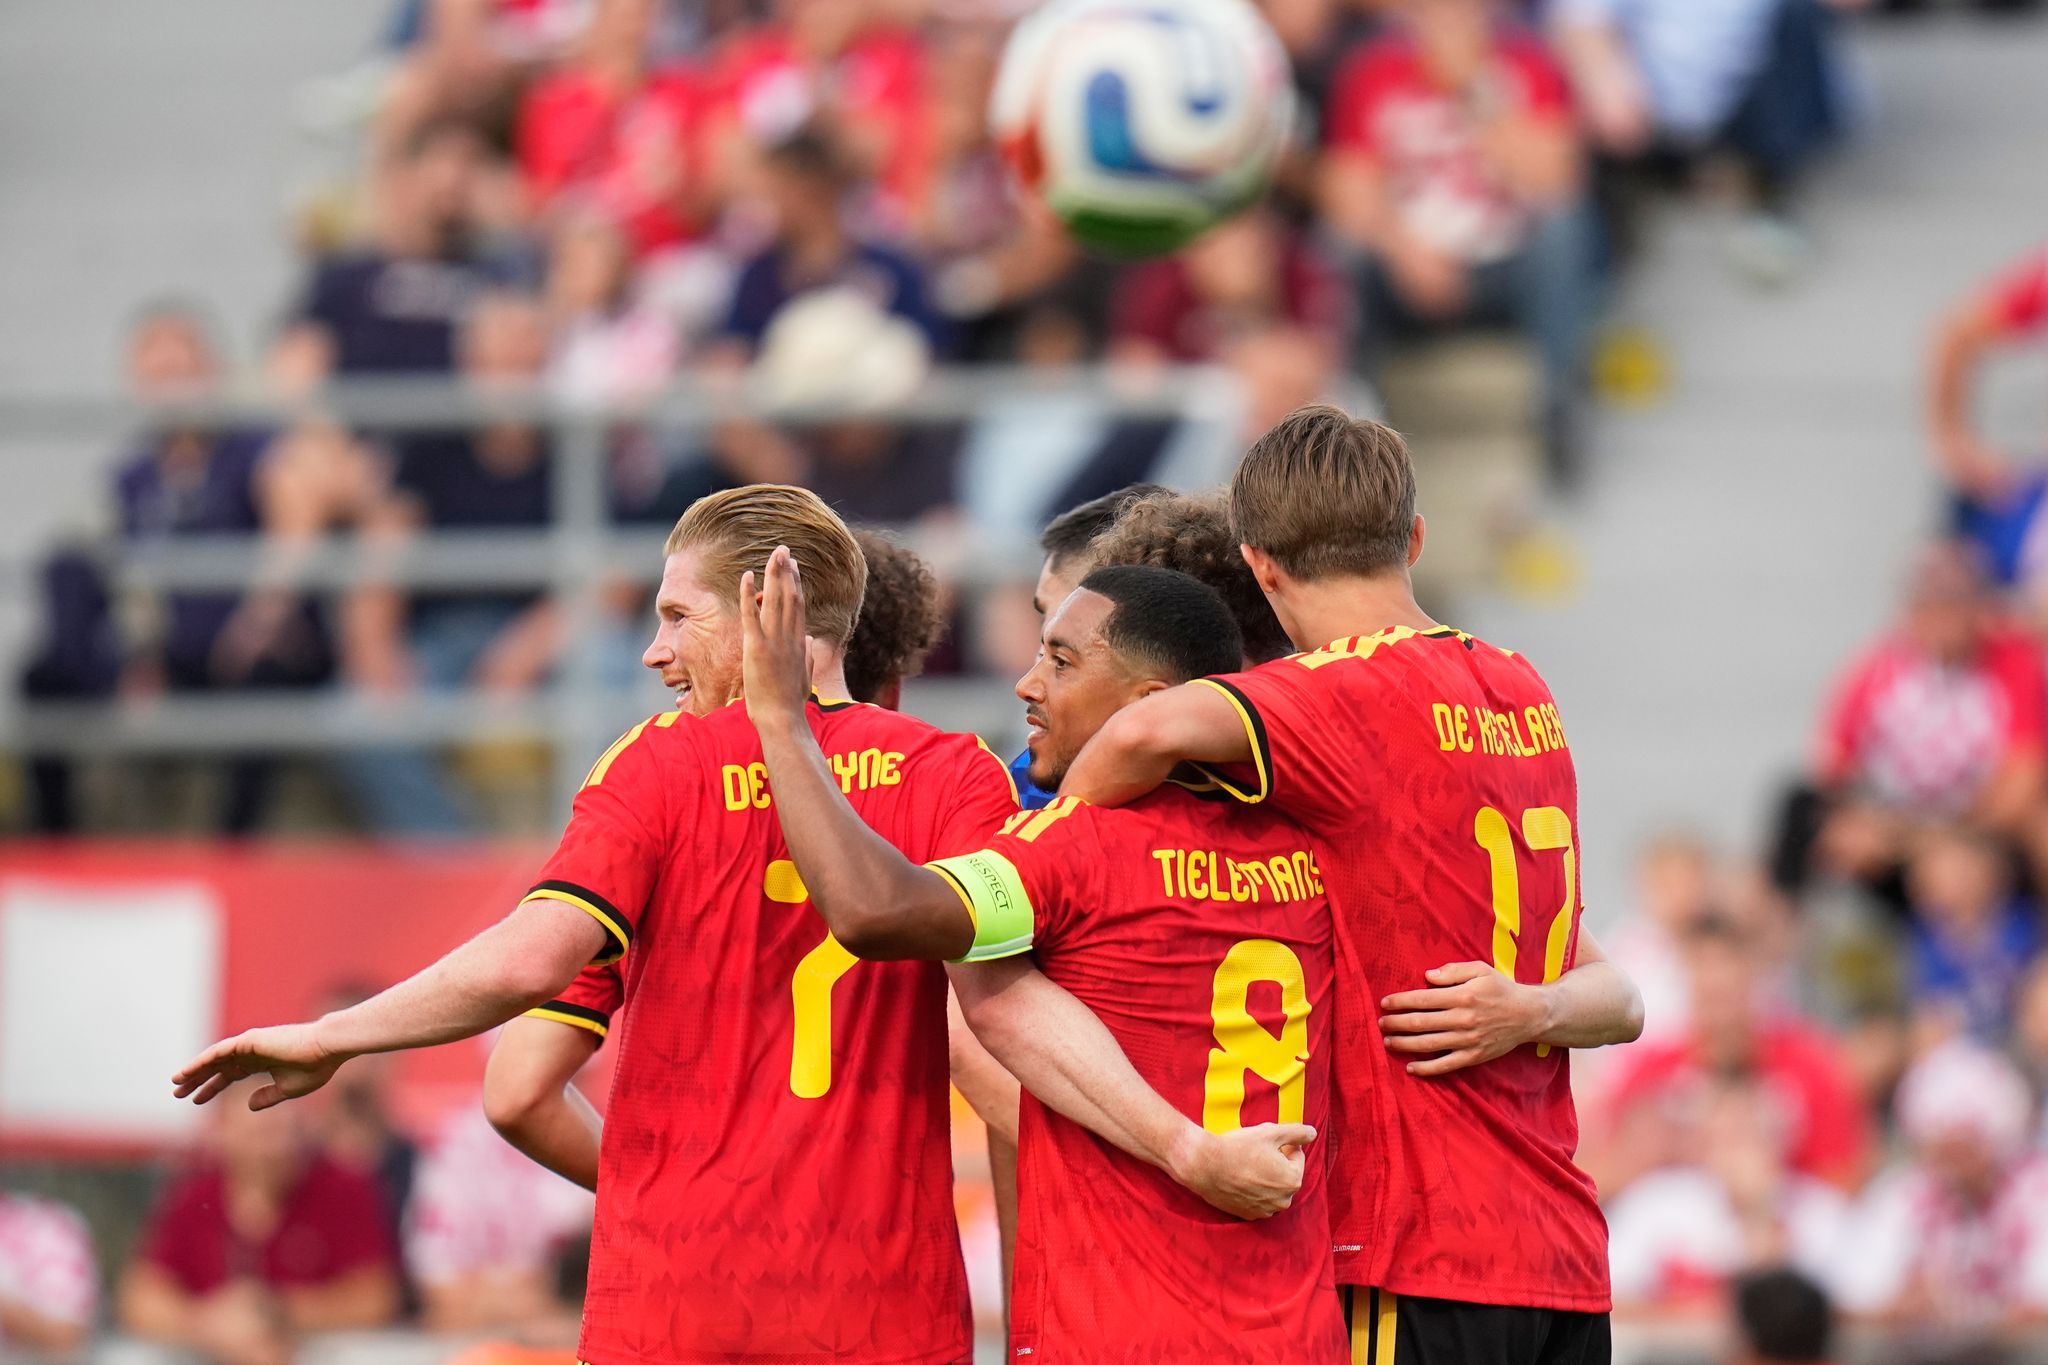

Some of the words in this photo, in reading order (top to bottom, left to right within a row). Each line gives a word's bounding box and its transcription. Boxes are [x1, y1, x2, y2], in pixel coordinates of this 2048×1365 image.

[1432, 703, 1474, 752] DE
[722, 762, 771, 811] DE
[826, 748, 905, 793] YNE
[968, 857, 1010, 910] RESPECT
[1474, 806, 1575, 1056] 17
[1203, 939, 1312, 1135] 8
